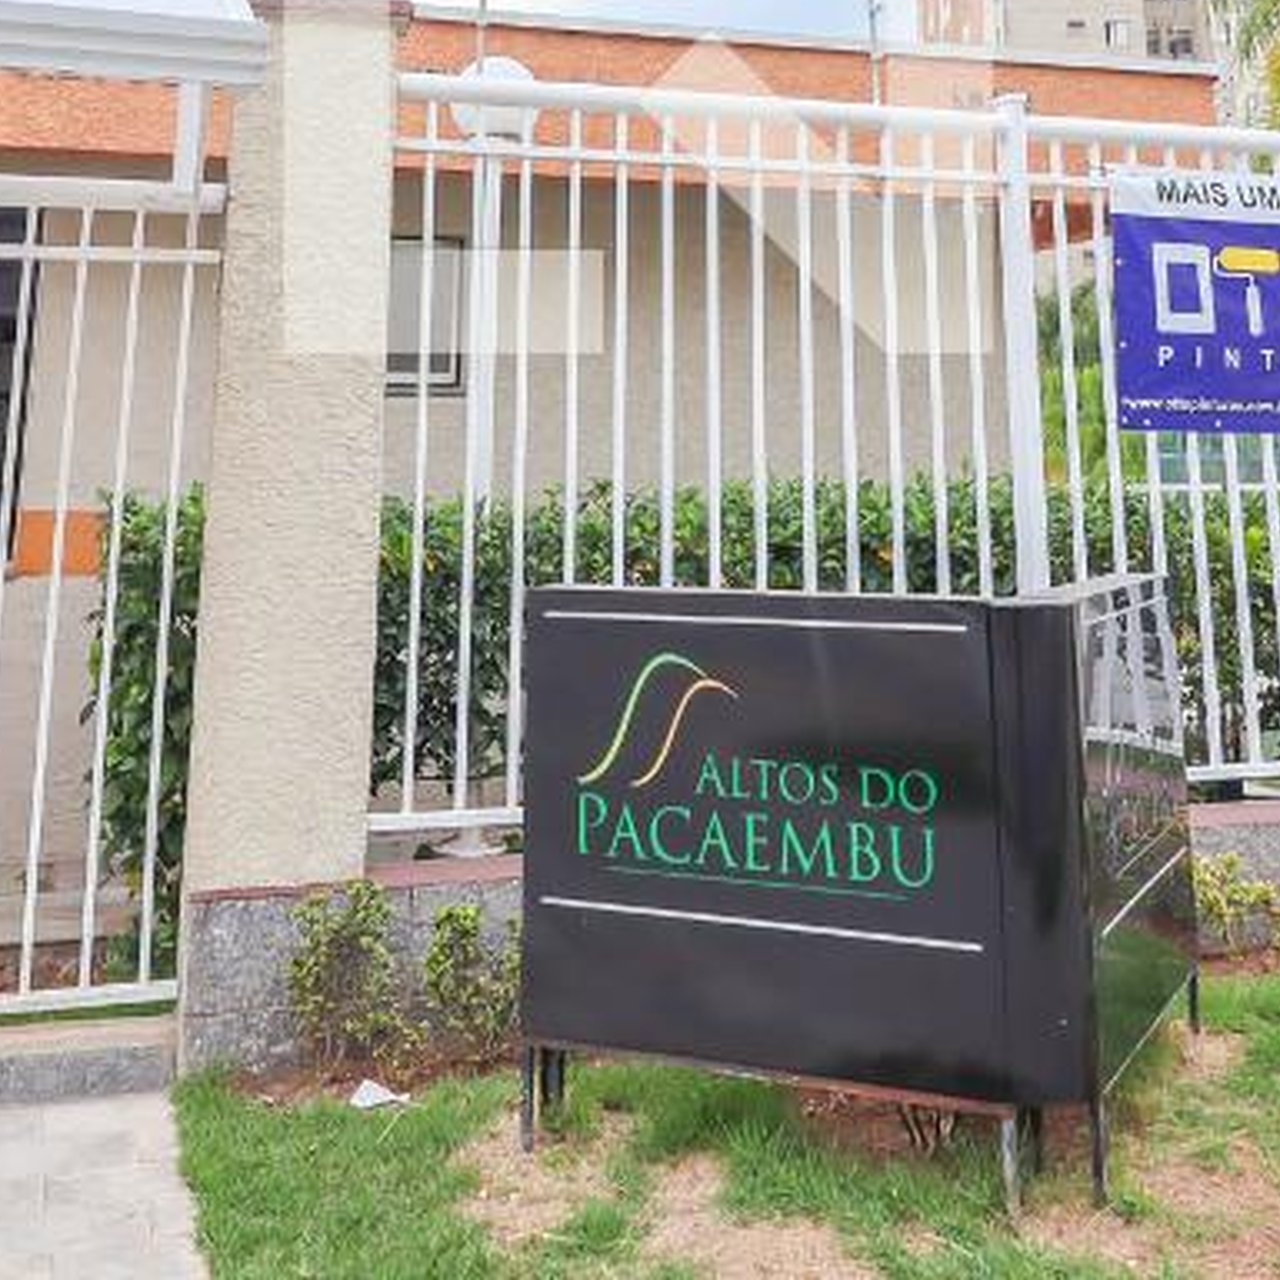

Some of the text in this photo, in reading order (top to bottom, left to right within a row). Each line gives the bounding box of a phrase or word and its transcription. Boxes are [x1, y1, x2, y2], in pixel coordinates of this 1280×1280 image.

[1154, 179, 1229, 209] MAIS
[695, 753, 939, 815] ALTOS DO
[575, 791, 937, 888] PACAEMBU
